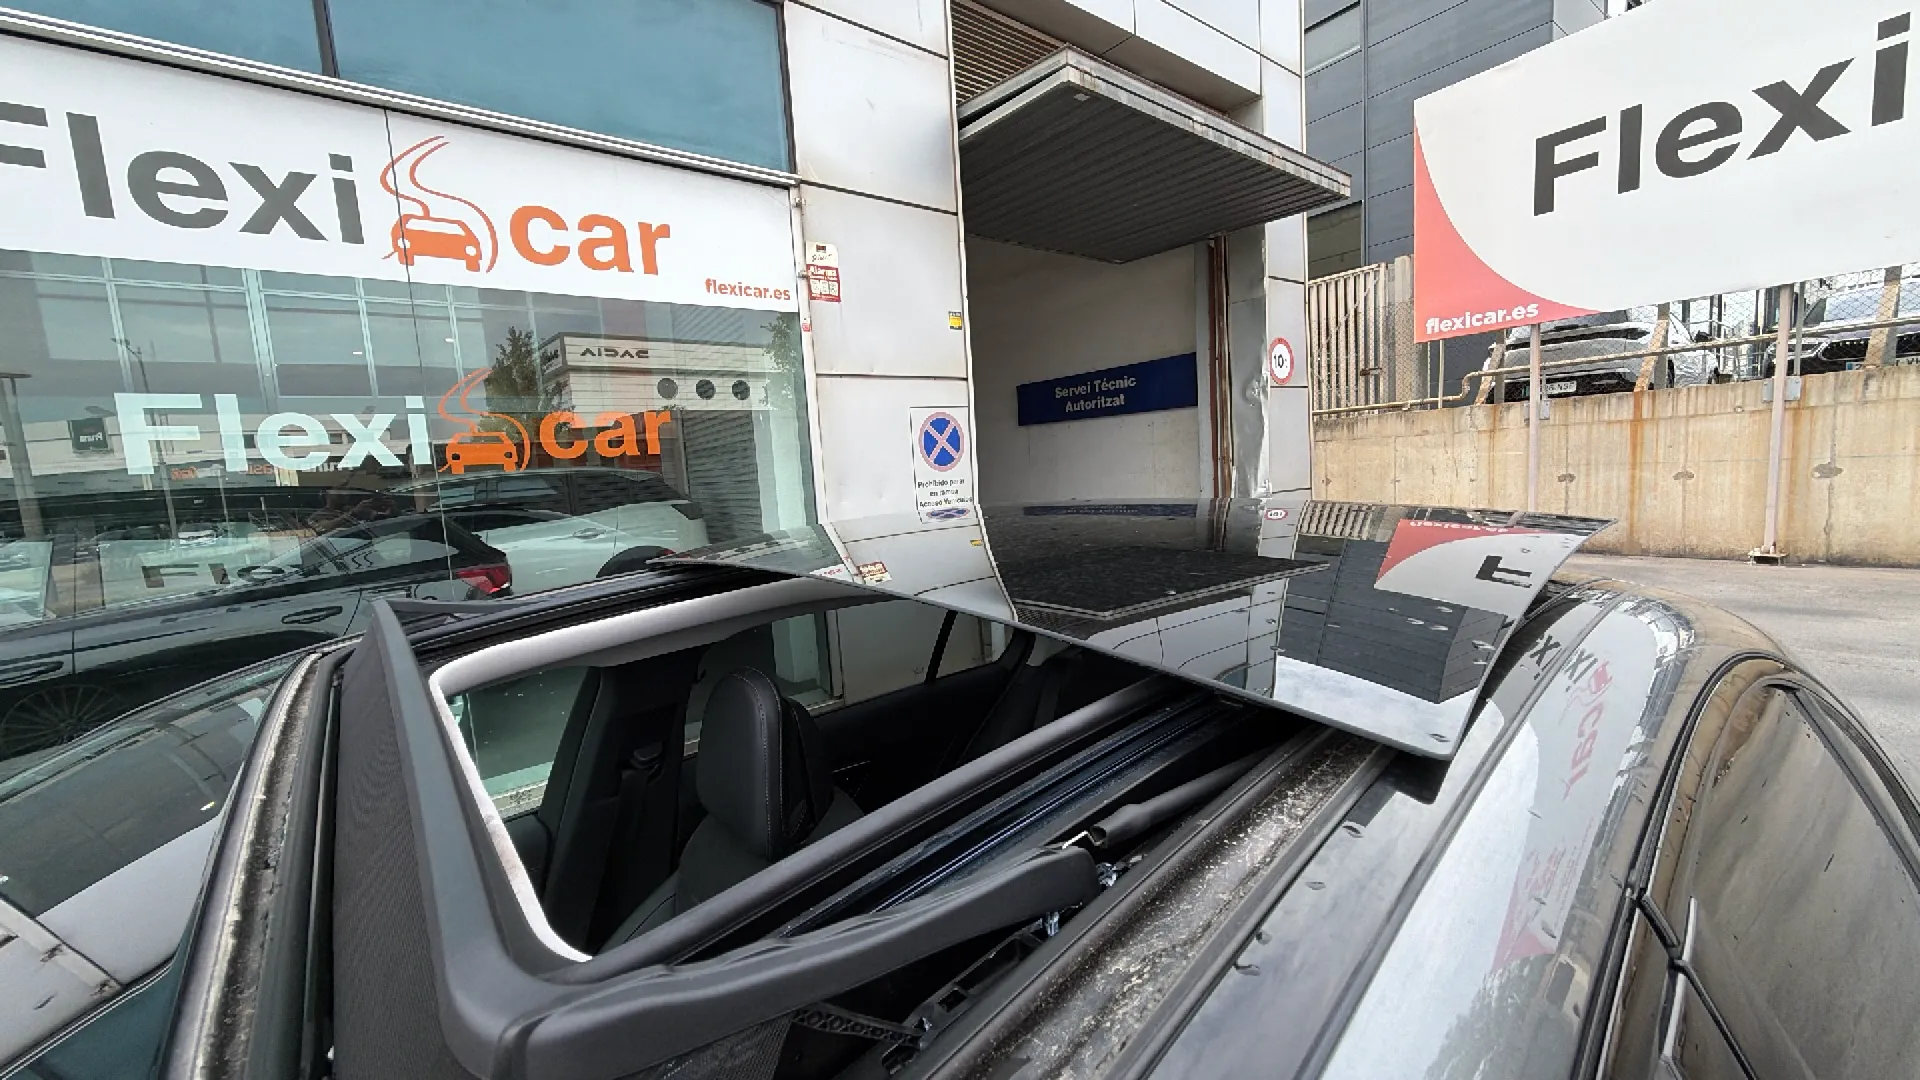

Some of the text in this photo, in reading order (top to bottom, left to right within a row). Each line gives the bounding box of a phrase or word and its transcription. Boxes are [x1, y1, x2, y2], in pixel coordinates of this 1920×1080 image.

[1533, 12, 1911, 217] Flexi
[509, 205, 671, 276] car
[705, 278, 791, 301] flexicar.es
[1425, 303, 1539, 335] flexicar.es
[1055, 375, 1137, 399] Servei Técnic
[1065, 394, 1125, 413] Autoritzat
[114, 393, 672, 475] Flexi car
